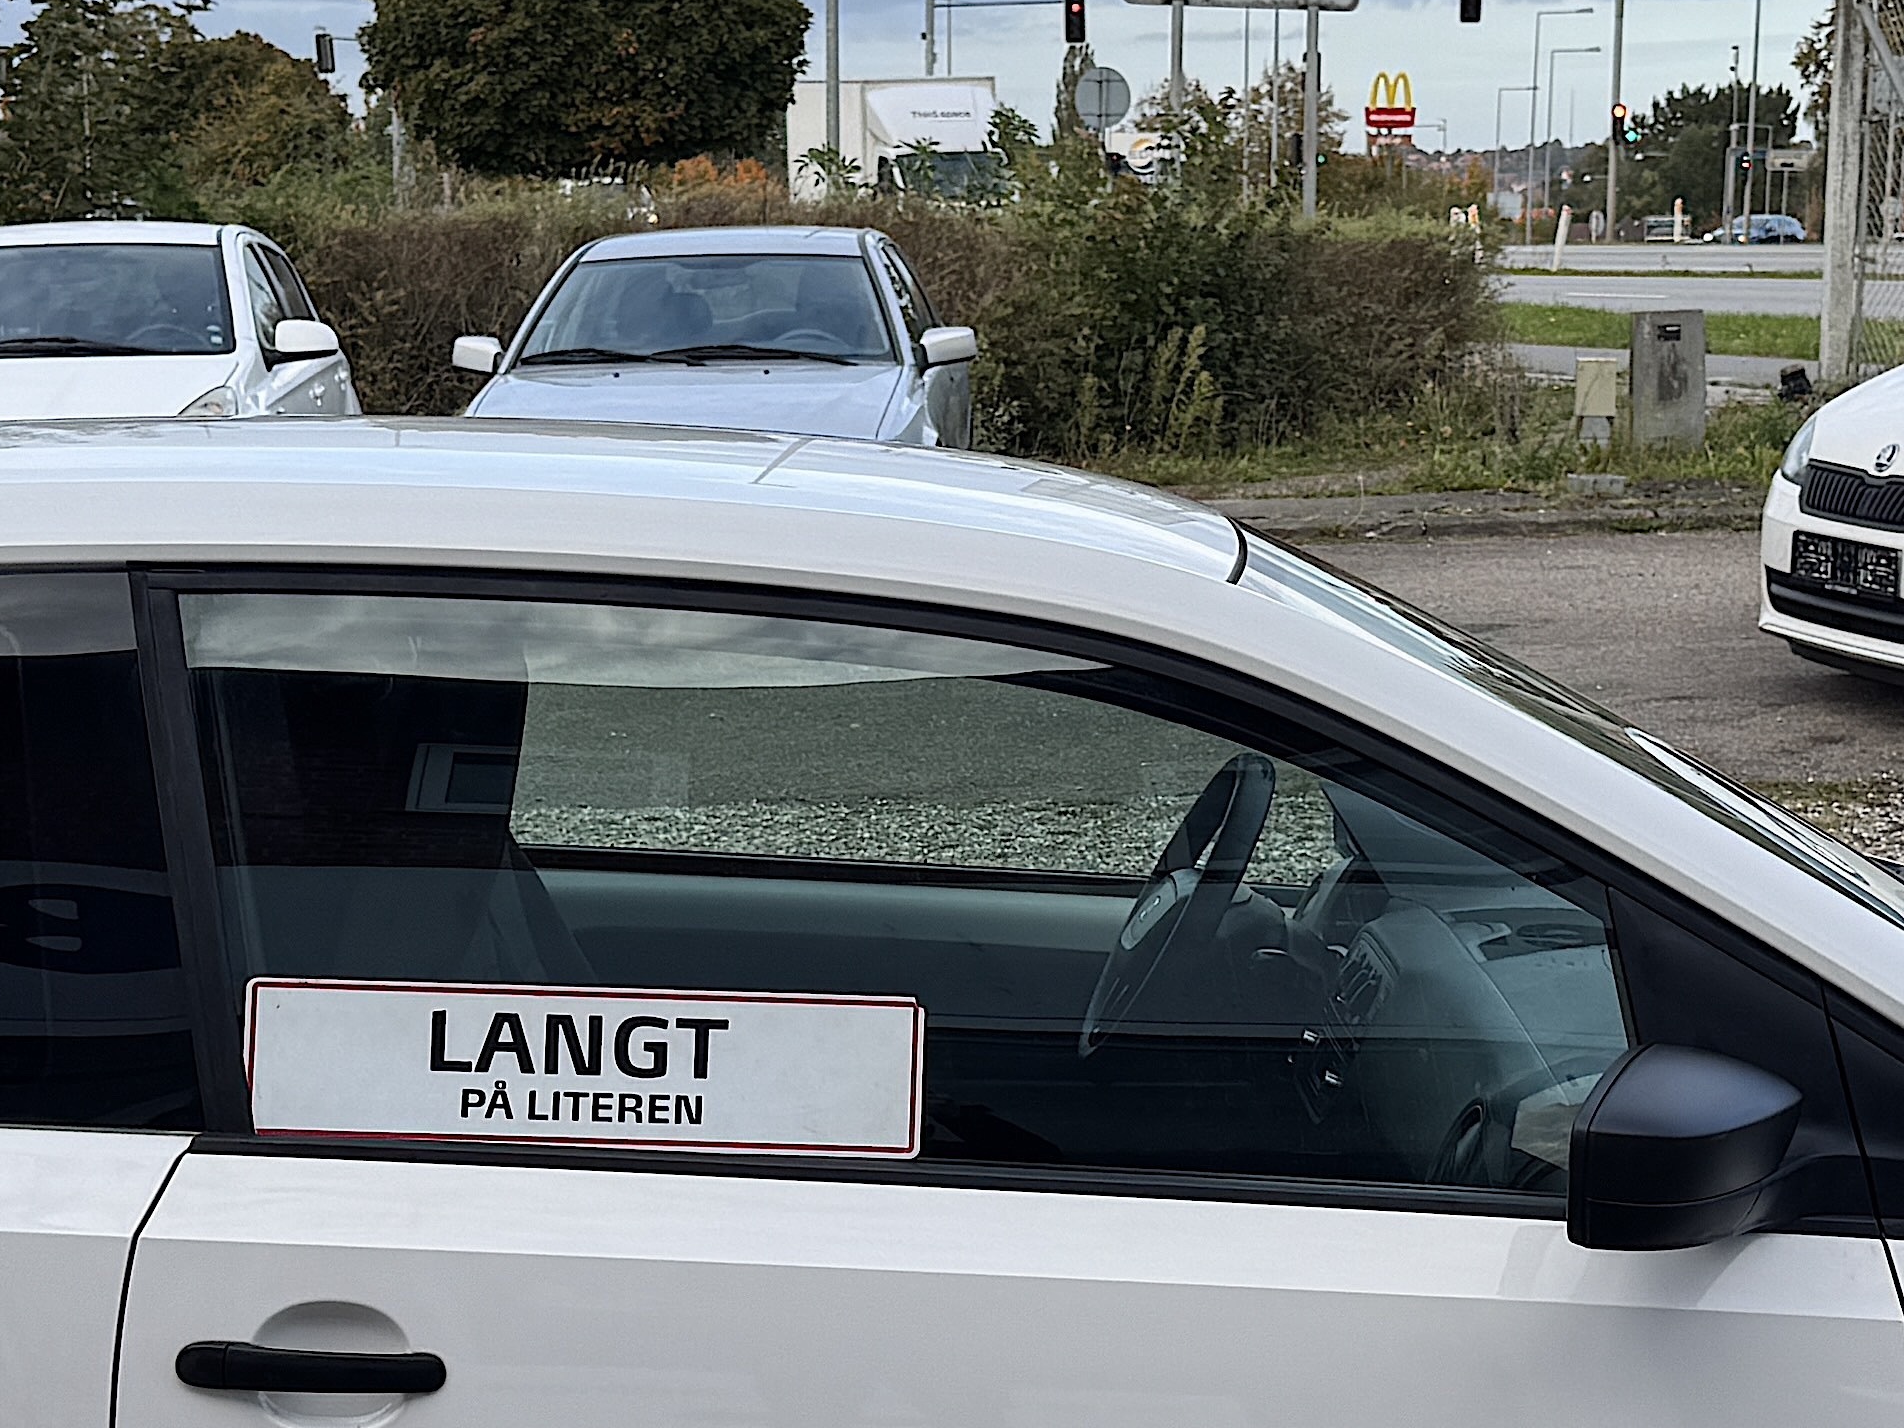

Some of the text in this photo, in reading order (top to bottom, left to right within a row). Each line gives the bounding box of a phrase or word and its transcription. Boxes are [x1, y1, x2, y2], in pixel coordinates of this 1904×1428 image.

[430, 1009, 730, 1079] LANGT
[460, 1080, 703, 1125] PÅ LITEREN
